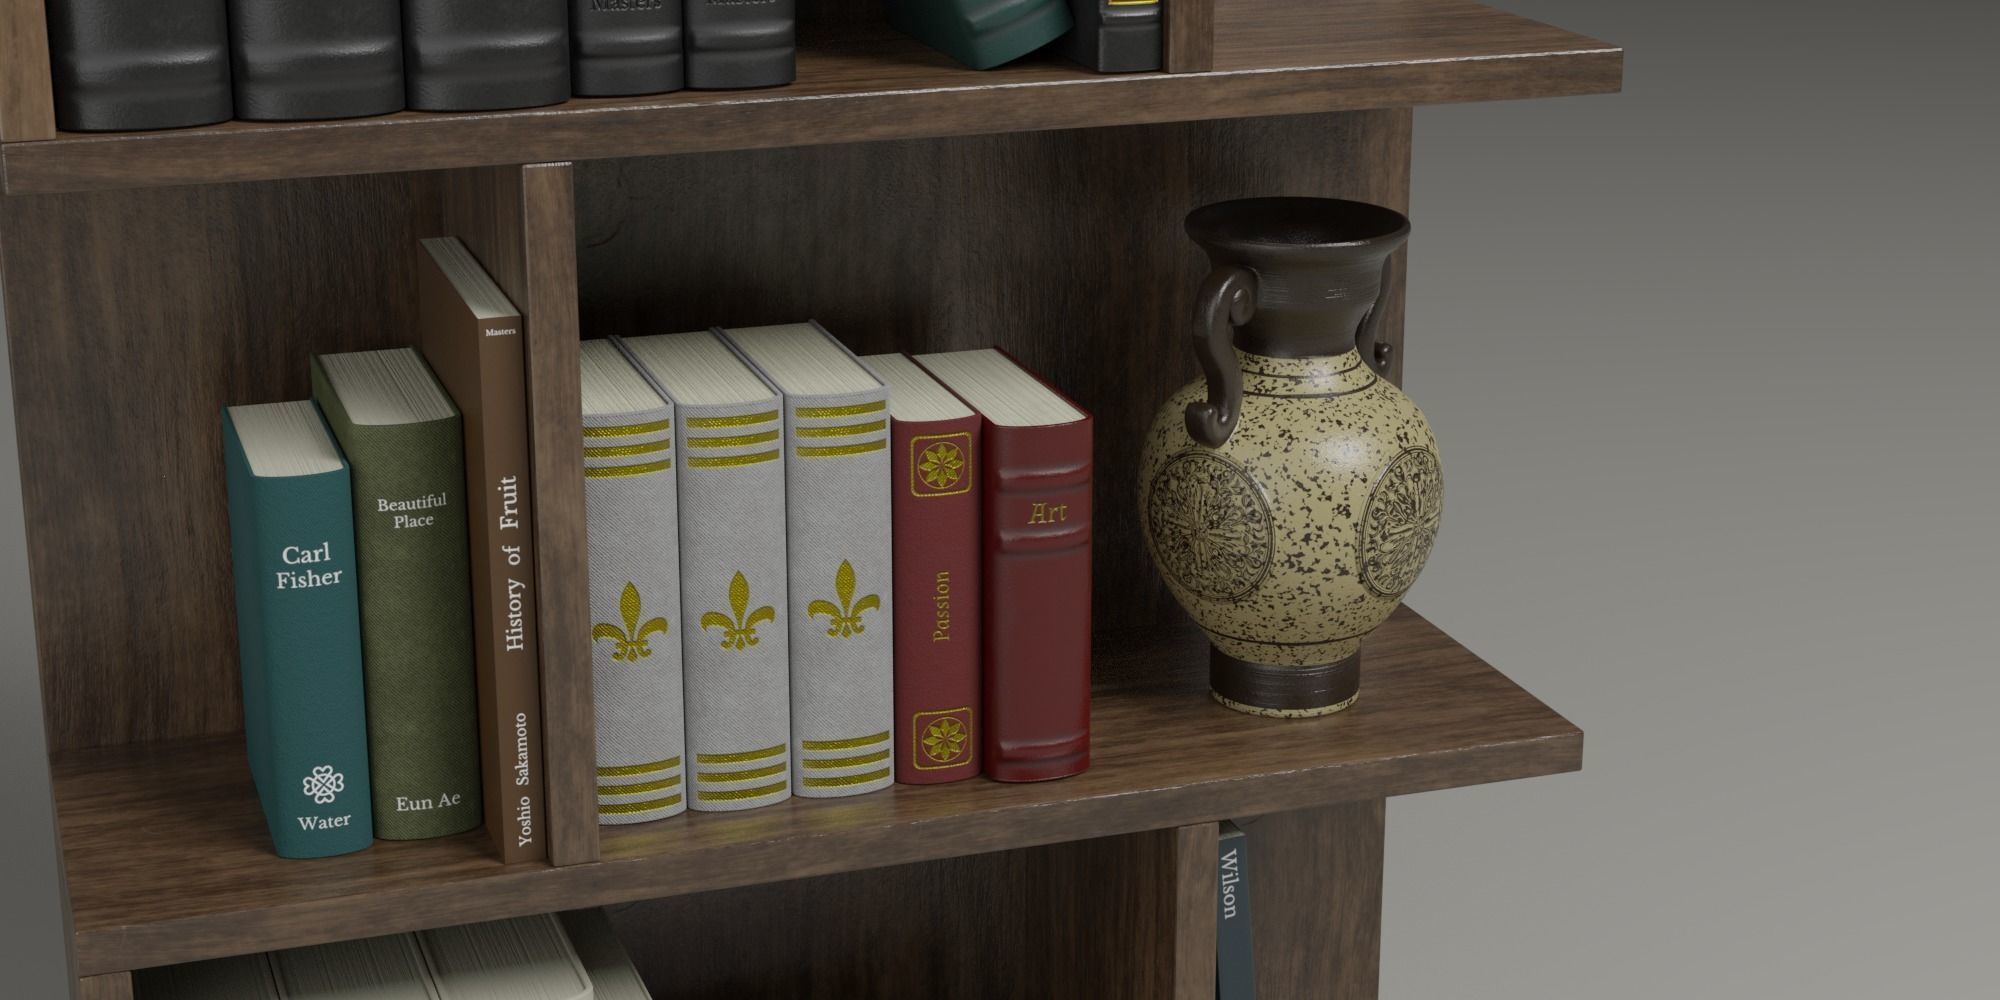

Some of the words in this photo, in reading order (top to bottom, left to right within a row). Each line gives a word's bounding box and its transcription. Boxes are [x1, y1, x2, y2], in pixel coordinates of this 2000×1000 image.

[485, 328, 516, 337] Masters
[377, 492, 447, 512] Beautiful
[497, 475, 519, 531] Fruit
[1027, 502, 1067, 525] Art
[393, 514, 434, 529] Place
[282, 541, 331, 565] Carl
[501, 545, 521, 566] of
[276, 569, 343, 589] Fisher
[505, 578, 526, 652] History
[932, 571, 950, 642] Passion
[514, 712, 530, 786] Sakamoto
[396, 796, 434, 812] Eun
[437, 792, 461, 808] Ae
[296, 814, 352, 831] Water
[516, 796, 532, 848] Yoshio
[1220, 848, 1240, 920] Wilson
